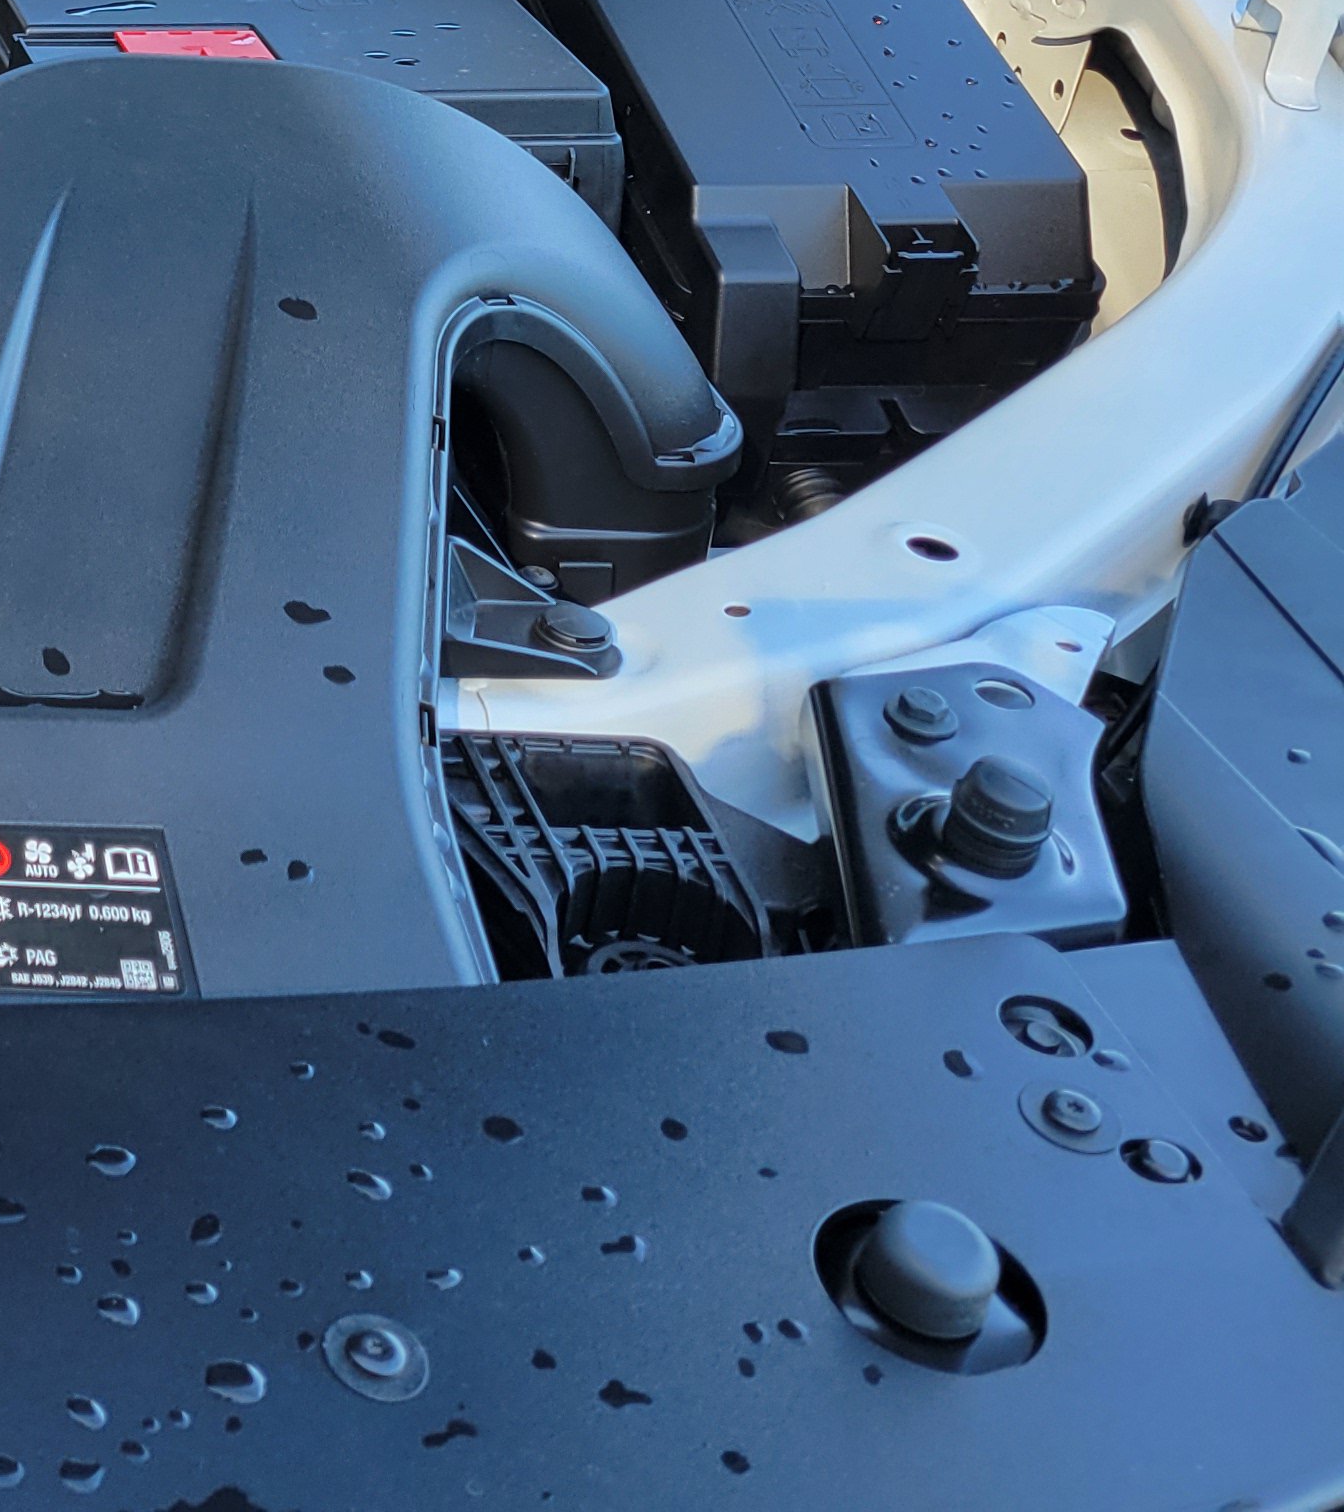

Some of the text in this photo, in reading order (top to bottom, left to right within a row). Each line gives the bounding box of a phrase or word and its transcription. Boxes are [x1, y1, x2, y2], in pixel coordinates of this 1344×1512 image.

[25, 864, 59, 879] AUTO
[17, 901, 153, 926] R-1234yf 0.600 kg
[26, 948, 58, 967] PAG
